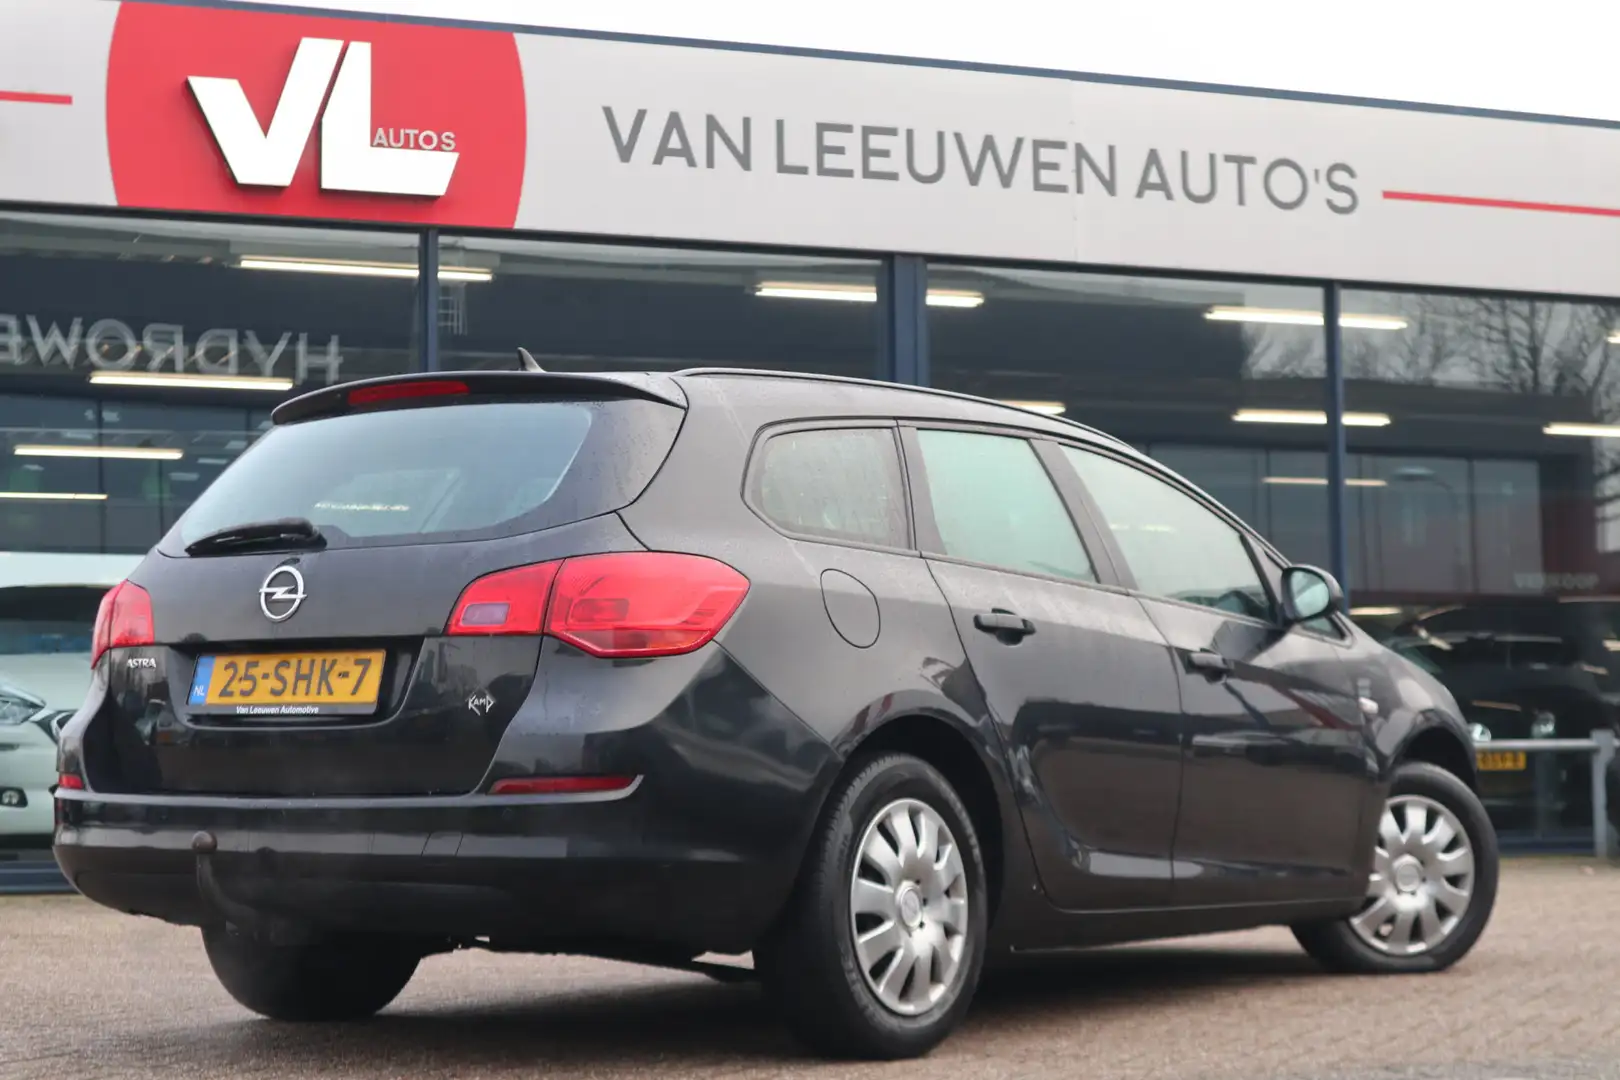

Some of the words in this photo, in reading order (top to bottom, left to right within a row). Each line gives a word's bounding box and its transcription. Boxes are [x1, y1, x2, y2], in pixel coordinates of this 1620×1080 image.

[185, 37, 460, 196] VL
[372, 127, 457, 151] AUTOS
[602, 105, 751, 171] VAN
[776, 118, 1117, 197] LEEUWEN
[1135, 148, 1360, 215] AUTO'S
[126, 657, 157, 669] ASTRA
[218, 658, 373, 698] 25-SHK-7
[193, 684, 206, 697] NL
[235, 706, 249, 714] Van
[250, 706, 279, 715] Leeuwen
[280, 706, 319, 714] Automotive
